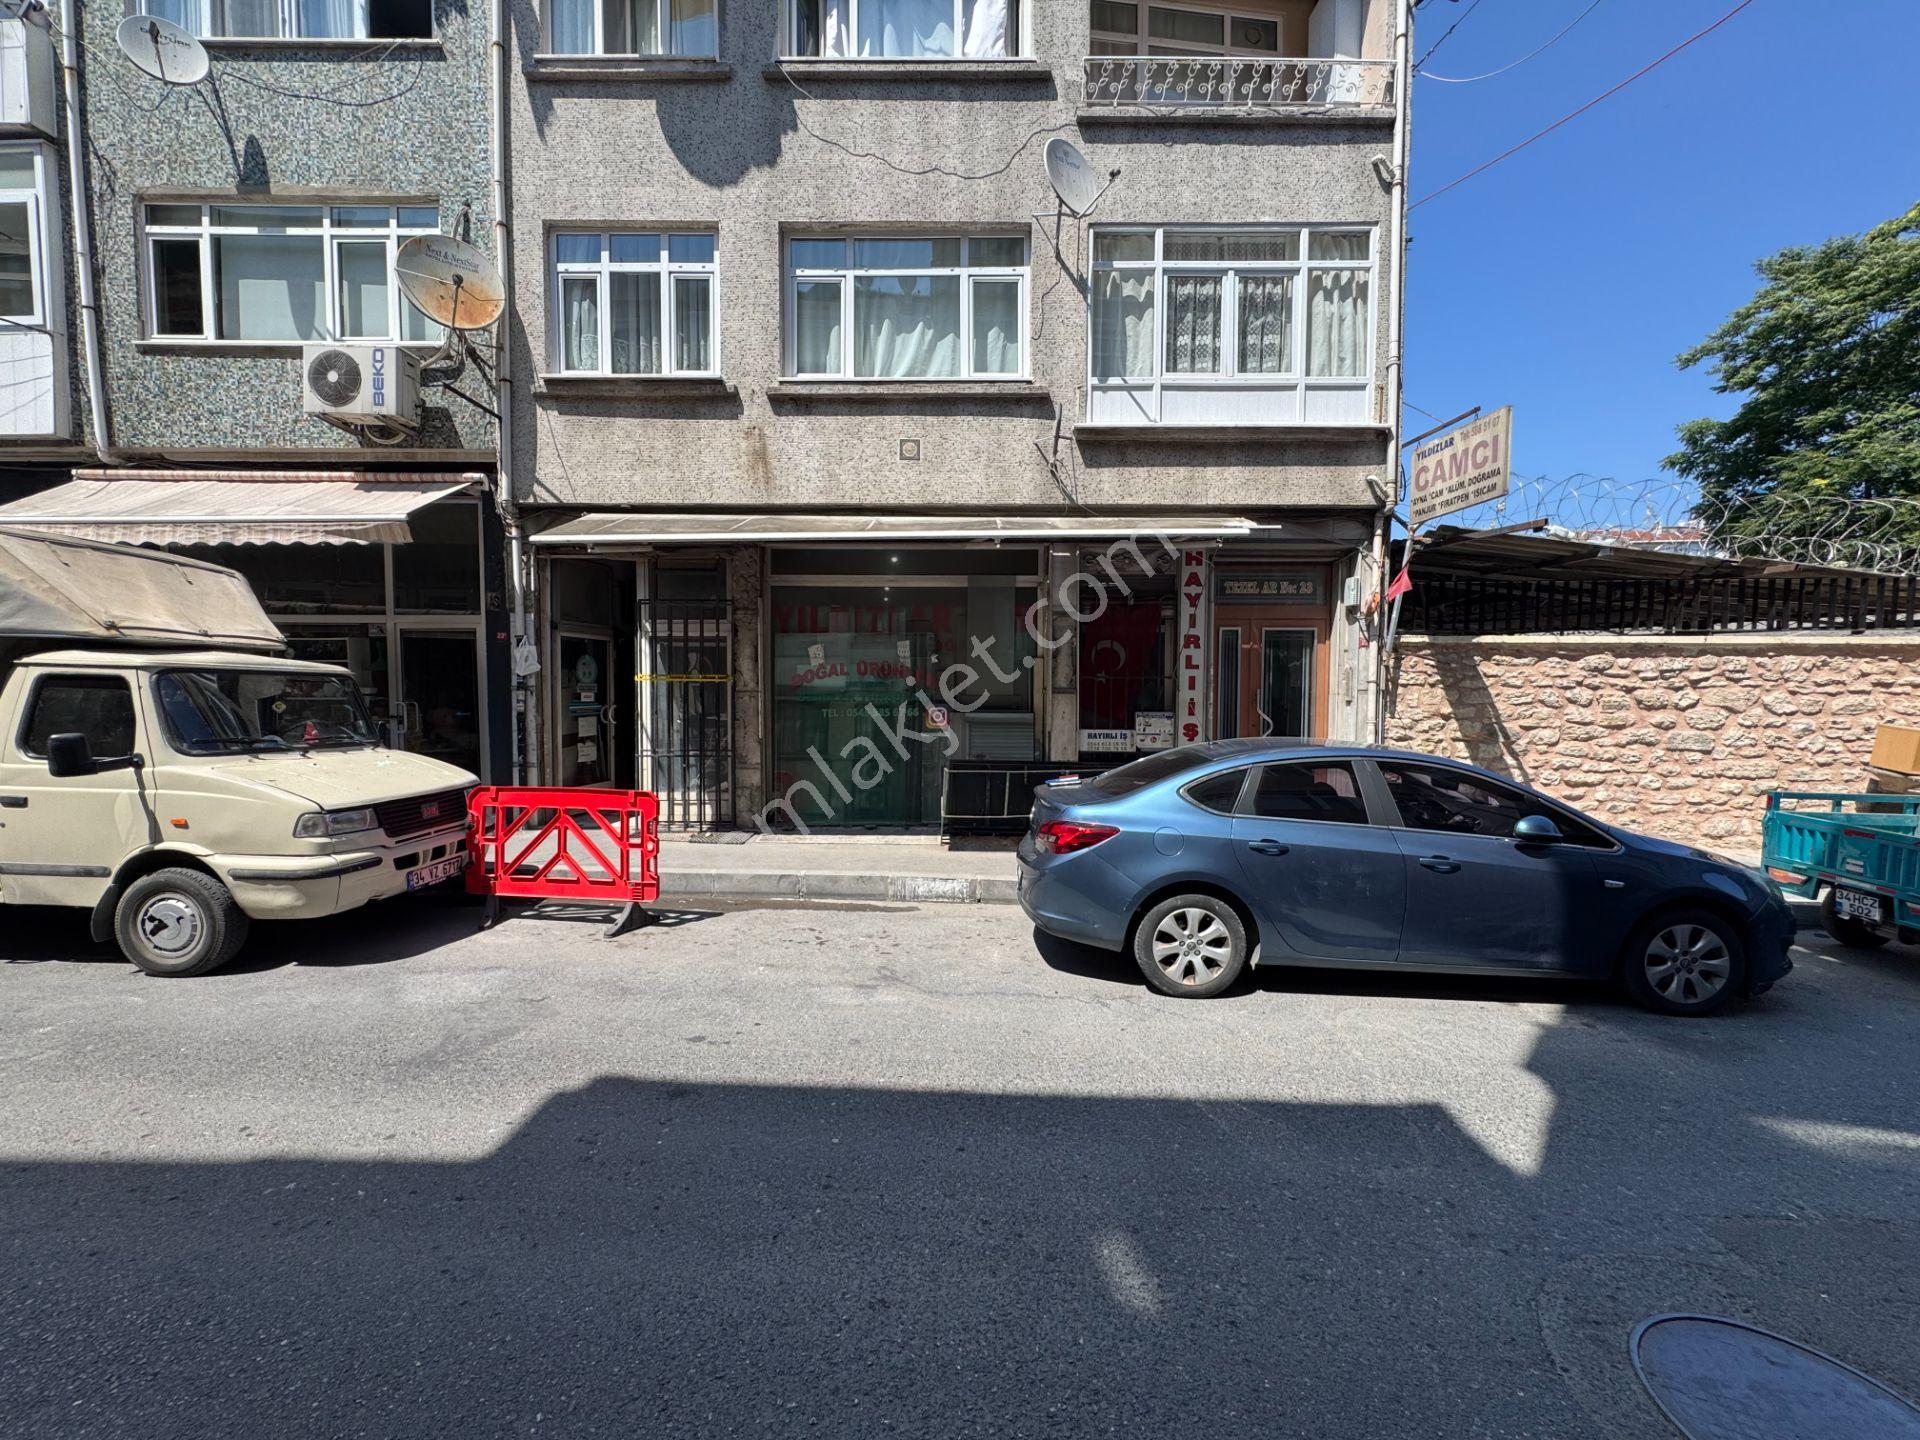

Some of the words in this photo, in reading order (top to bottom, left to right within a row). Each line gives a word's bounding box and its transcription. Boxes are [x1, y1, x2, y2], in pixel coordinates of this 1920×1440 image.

[371, 348, 385, 406] BEKO
[1416, 437, 1455, 462] YILDIZLAR
[1414, 434, 1499, 492] CAMCI
[1468, 467, 1501, 487] DOĞRAMA
[1224, 581, 1259, 594] TEZEL
[1182, 551, 1204, 691] HAYIRLI
[789, 662, 849, 687] DOĞAL
[1087, 732, 1117, 740] HAYIRLI
[413, 870, 425, 885] 34
[1837, 890, 1851, 903] 34
[1852, 893, 1878, 910] HCZ
[1849, 903, 1873, 918] 502
